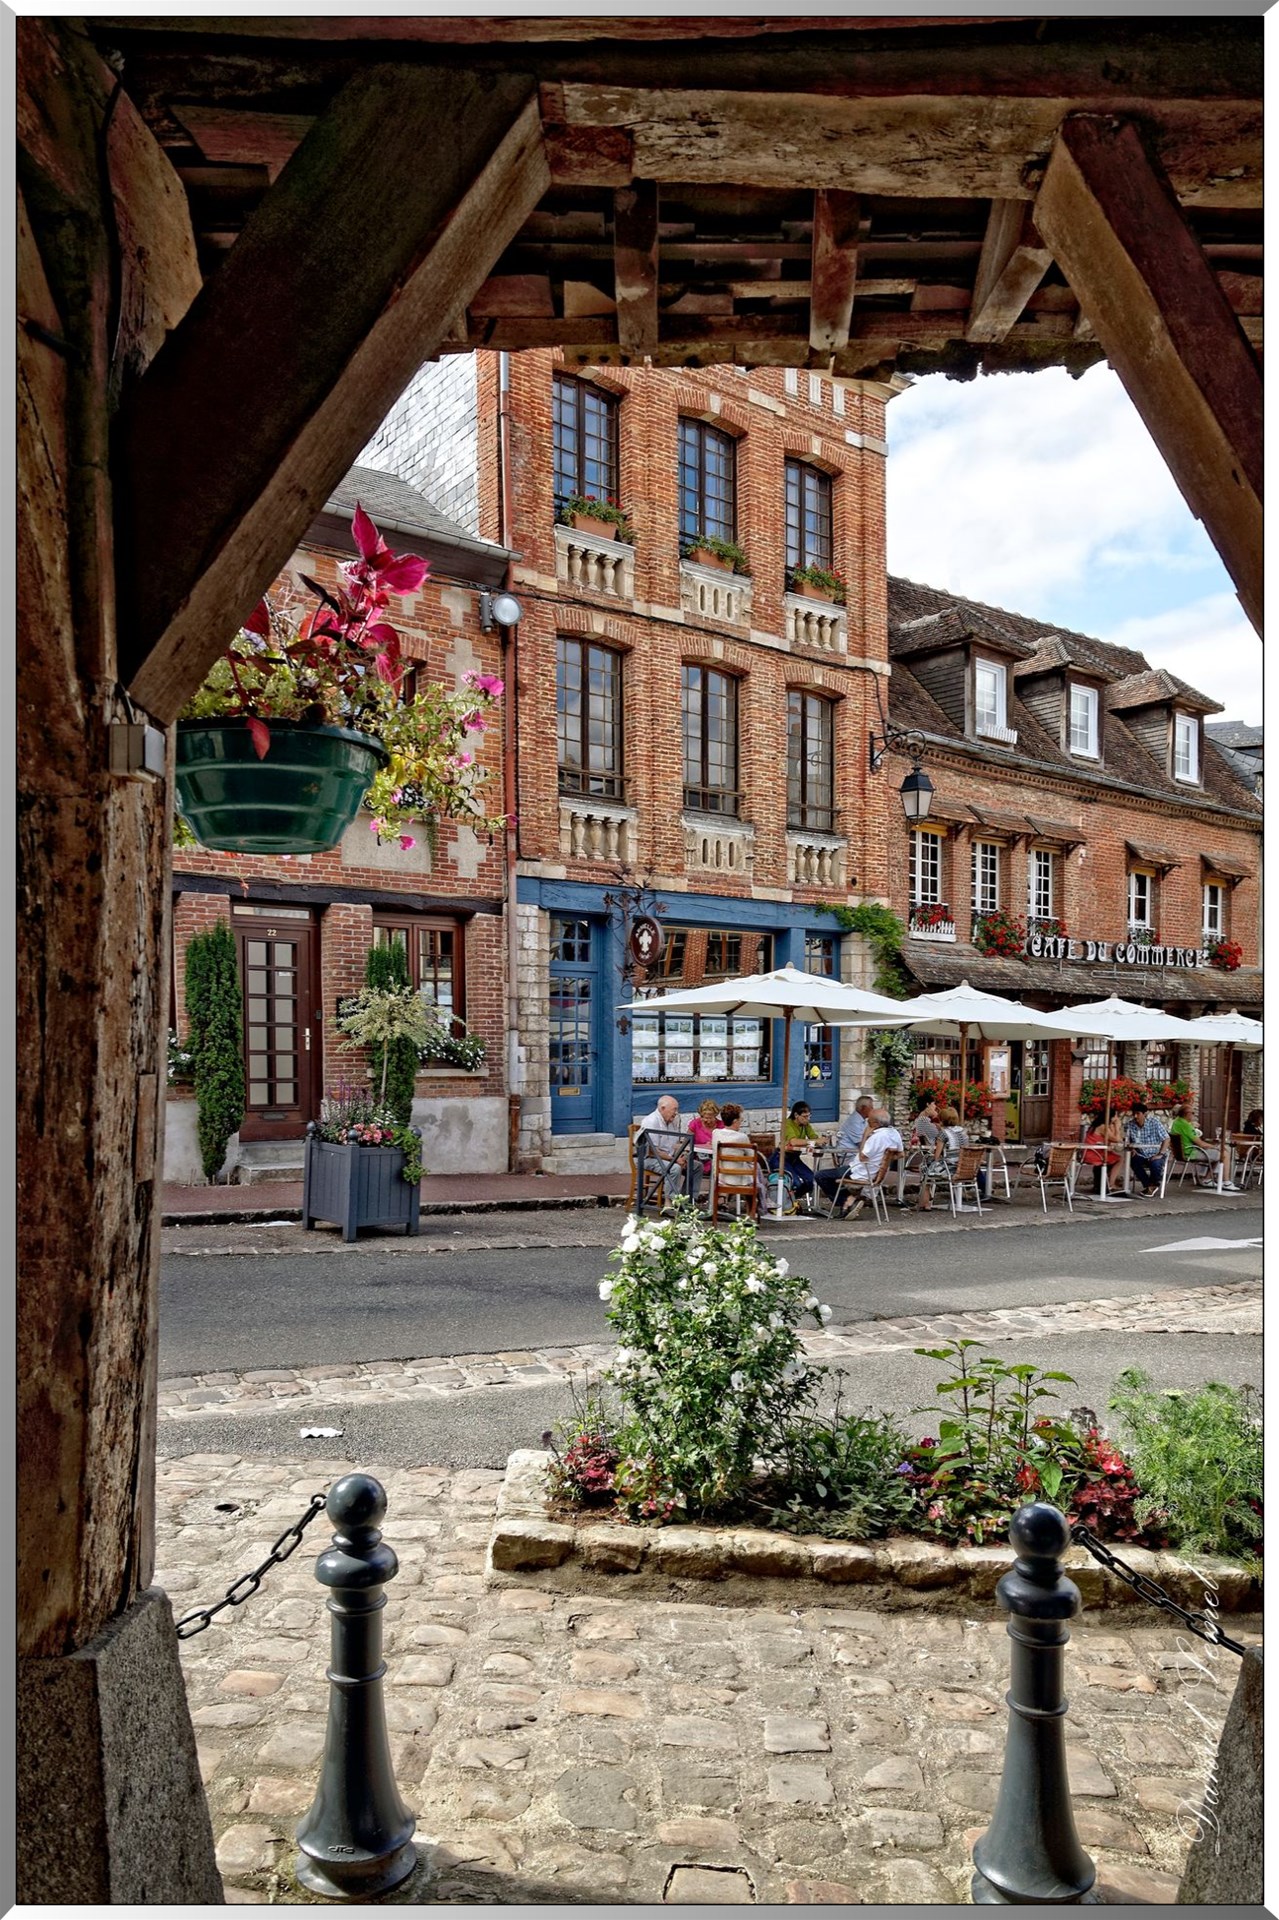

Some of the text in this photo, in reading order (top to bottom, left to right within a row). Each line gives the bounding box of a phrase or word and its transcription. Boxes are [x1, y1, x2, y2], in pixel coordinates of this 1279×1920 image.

[266, 929, 277, 937] 22
[1086, 940, 1113, 963] DU
[1115, 942, 1204, 968] COMMERCE
